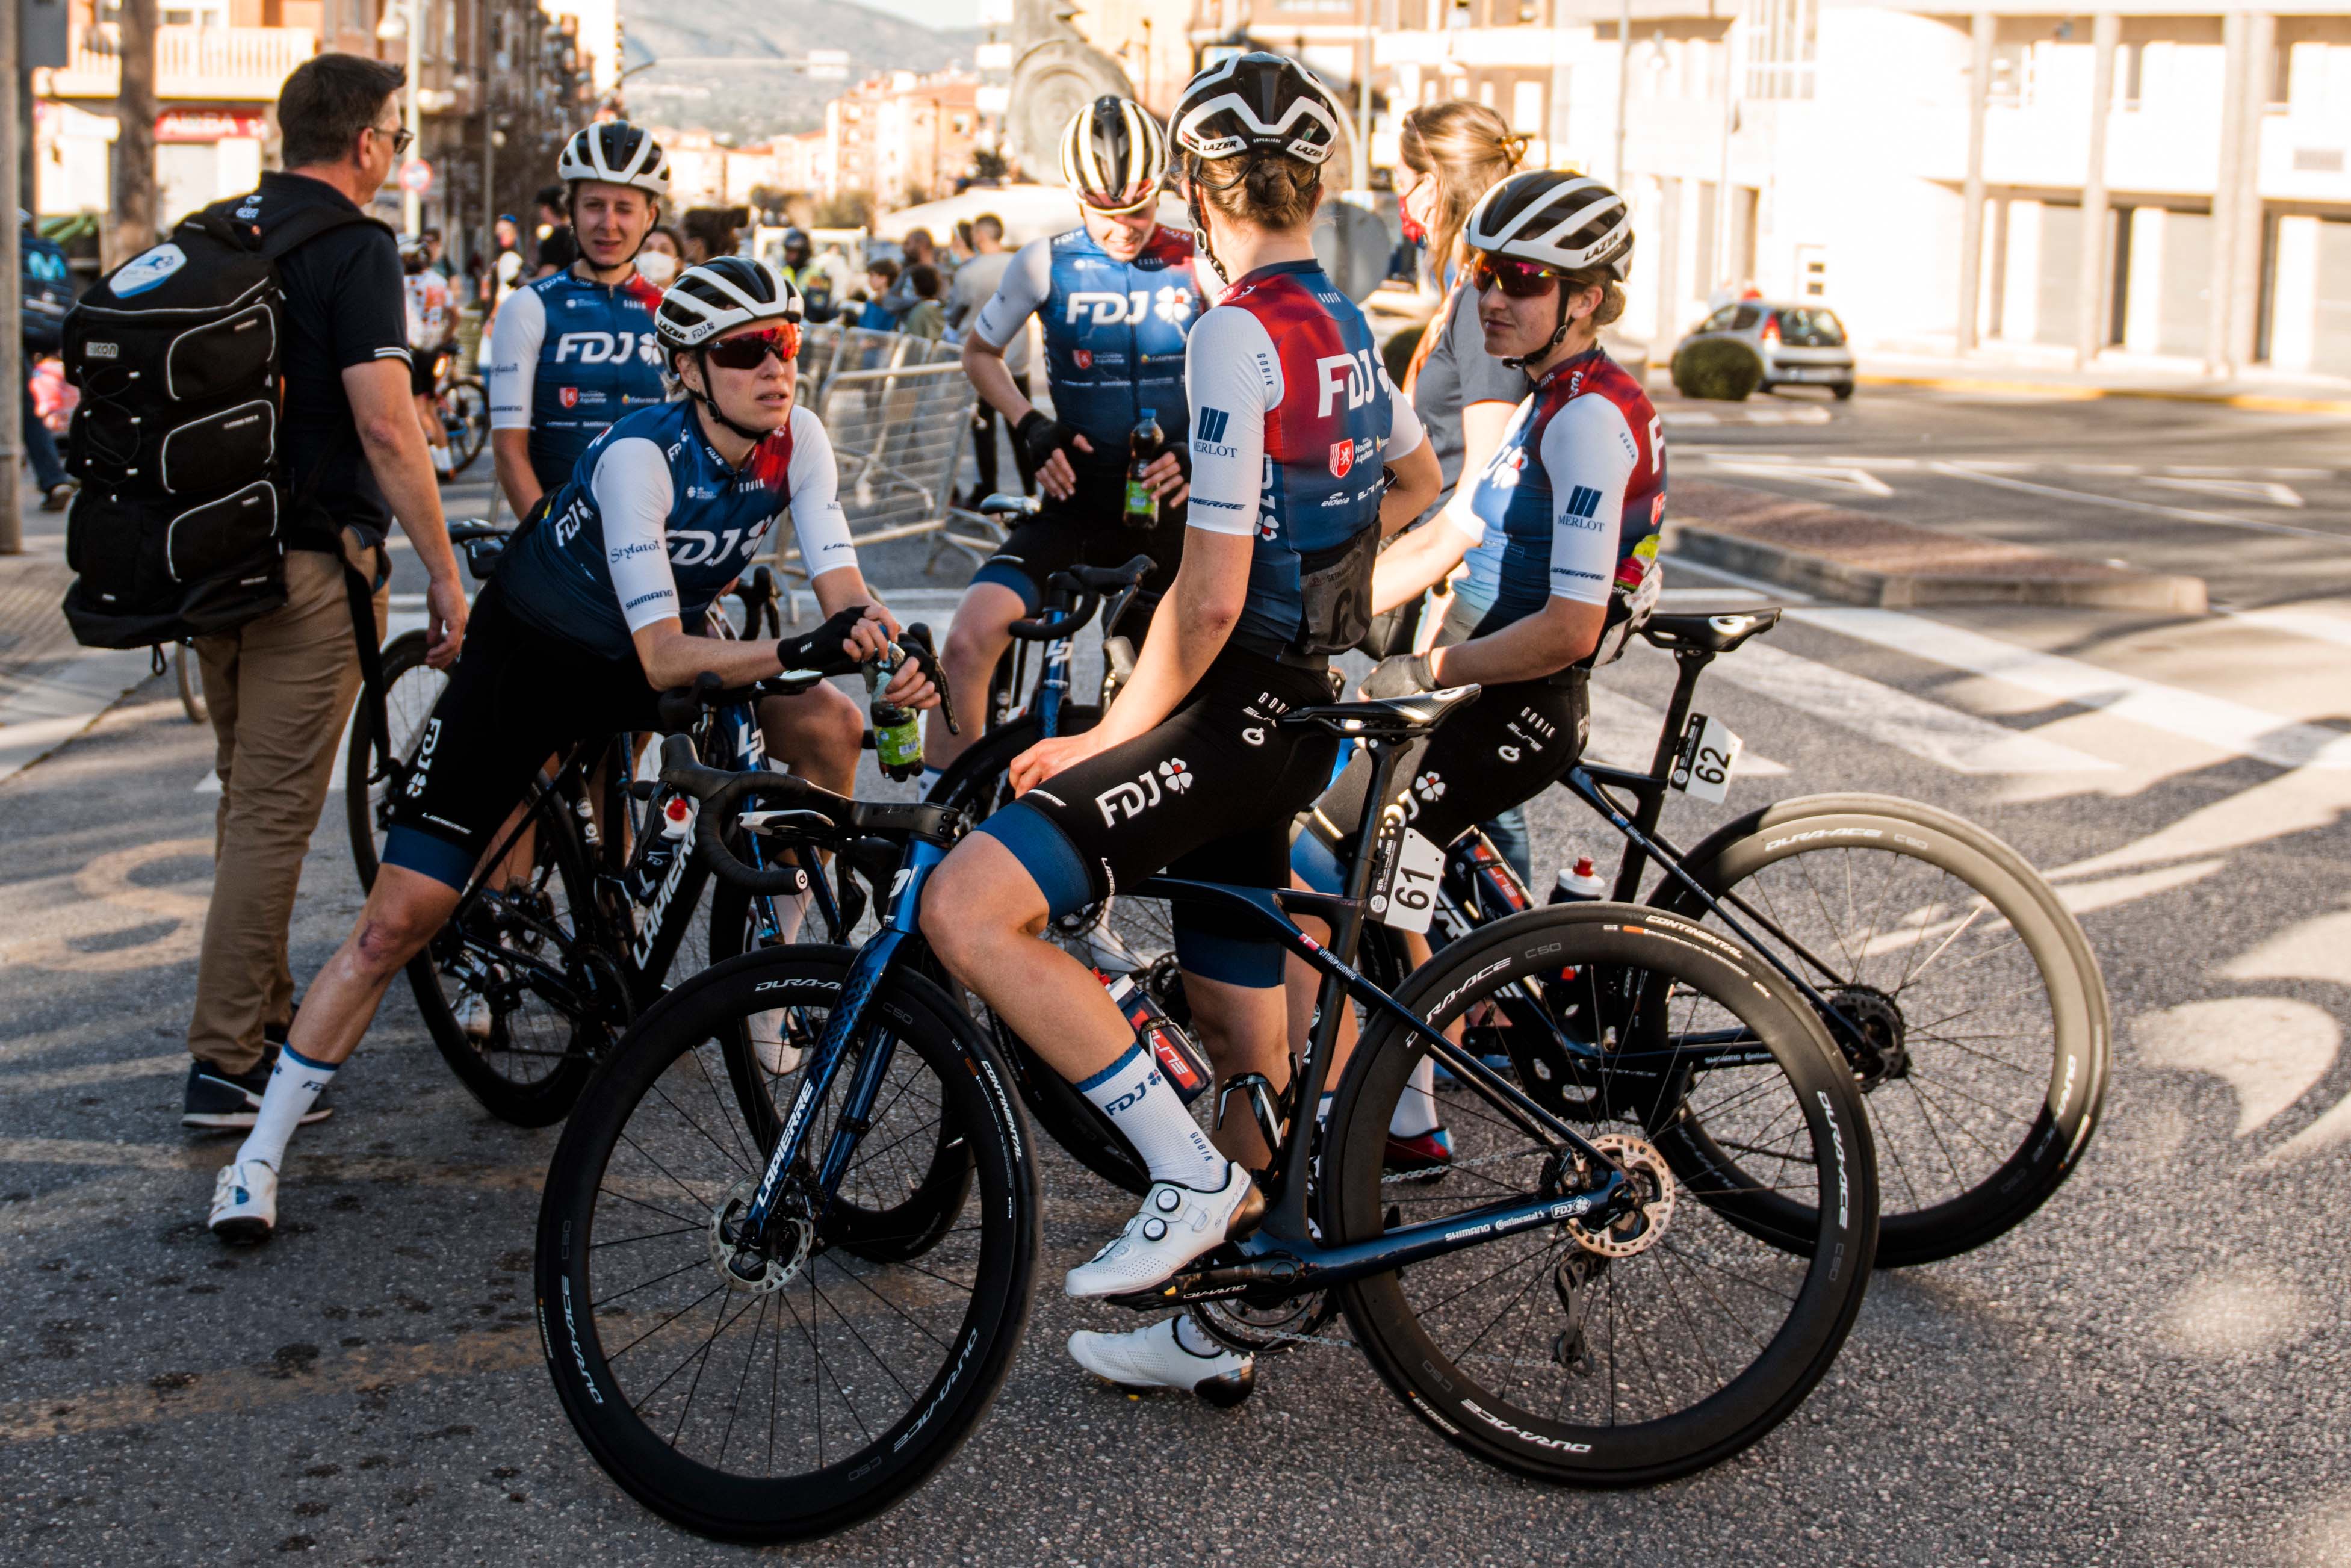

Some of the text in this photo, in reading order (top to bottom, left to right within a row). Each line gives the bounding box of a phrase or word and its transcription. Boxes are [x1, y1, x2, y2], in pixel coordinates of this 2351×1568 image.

[1203, 140, 1237, 151] LAZER
[1295, 144, 1324, 158] LAZER
[1584, 231, 1618, 261] LAZER
[1066, 291, 1150, 325] FDJ
[554, 332, 635, 364] FDJ
[658, 320, 687, 341] LAZER
[692, 325, 707, 339] FDJ
[1256, 353, 1274, 386] GOBIK
[1316, 350, 1375, 418] FDJ
[555, 503, 581, 547] FDJ
[1557, 514, 1605, 533] MERLOT
[625, 589, 674, 611] SHIMANO
[1520, 705, 1556, 739] GOBIK
[417, 717, 442, 771] FDJ
[1694, 746, 1732, 784] 62
[1095, 770, 1162, 829] FDJ
[1764, 828, 1883, 852] DURA-ACE
[1394, 866, 1436, 911] 61
[1525, 942, 1563, 960] C50
[1645, 914, 1743, 960] CONTINENTAL
[1336, 962, 1358, 981] LUDWIG
[1405, 956, 1512, 1049] DRA-ACE
[980, 1060, 1023, 1163] CONTINENTAL
[1104, 1081, 1147, 1117] FDJ
[757, 1079, 815, 1206] LAPIERRE
[1189, 1131, 1214, 1162] GOBIK
[1816, 1090, 1850, 1230] DURA-ACE
[1444, 1203, 1573, 1241] SHIMANO Continental FDJ
[561, 1274, 604, 1405] DURA-ACE
[893, 1327, 978, 1452] DURA-ACE
[1460, 1398, 1593, 1454] DURA-ACE
